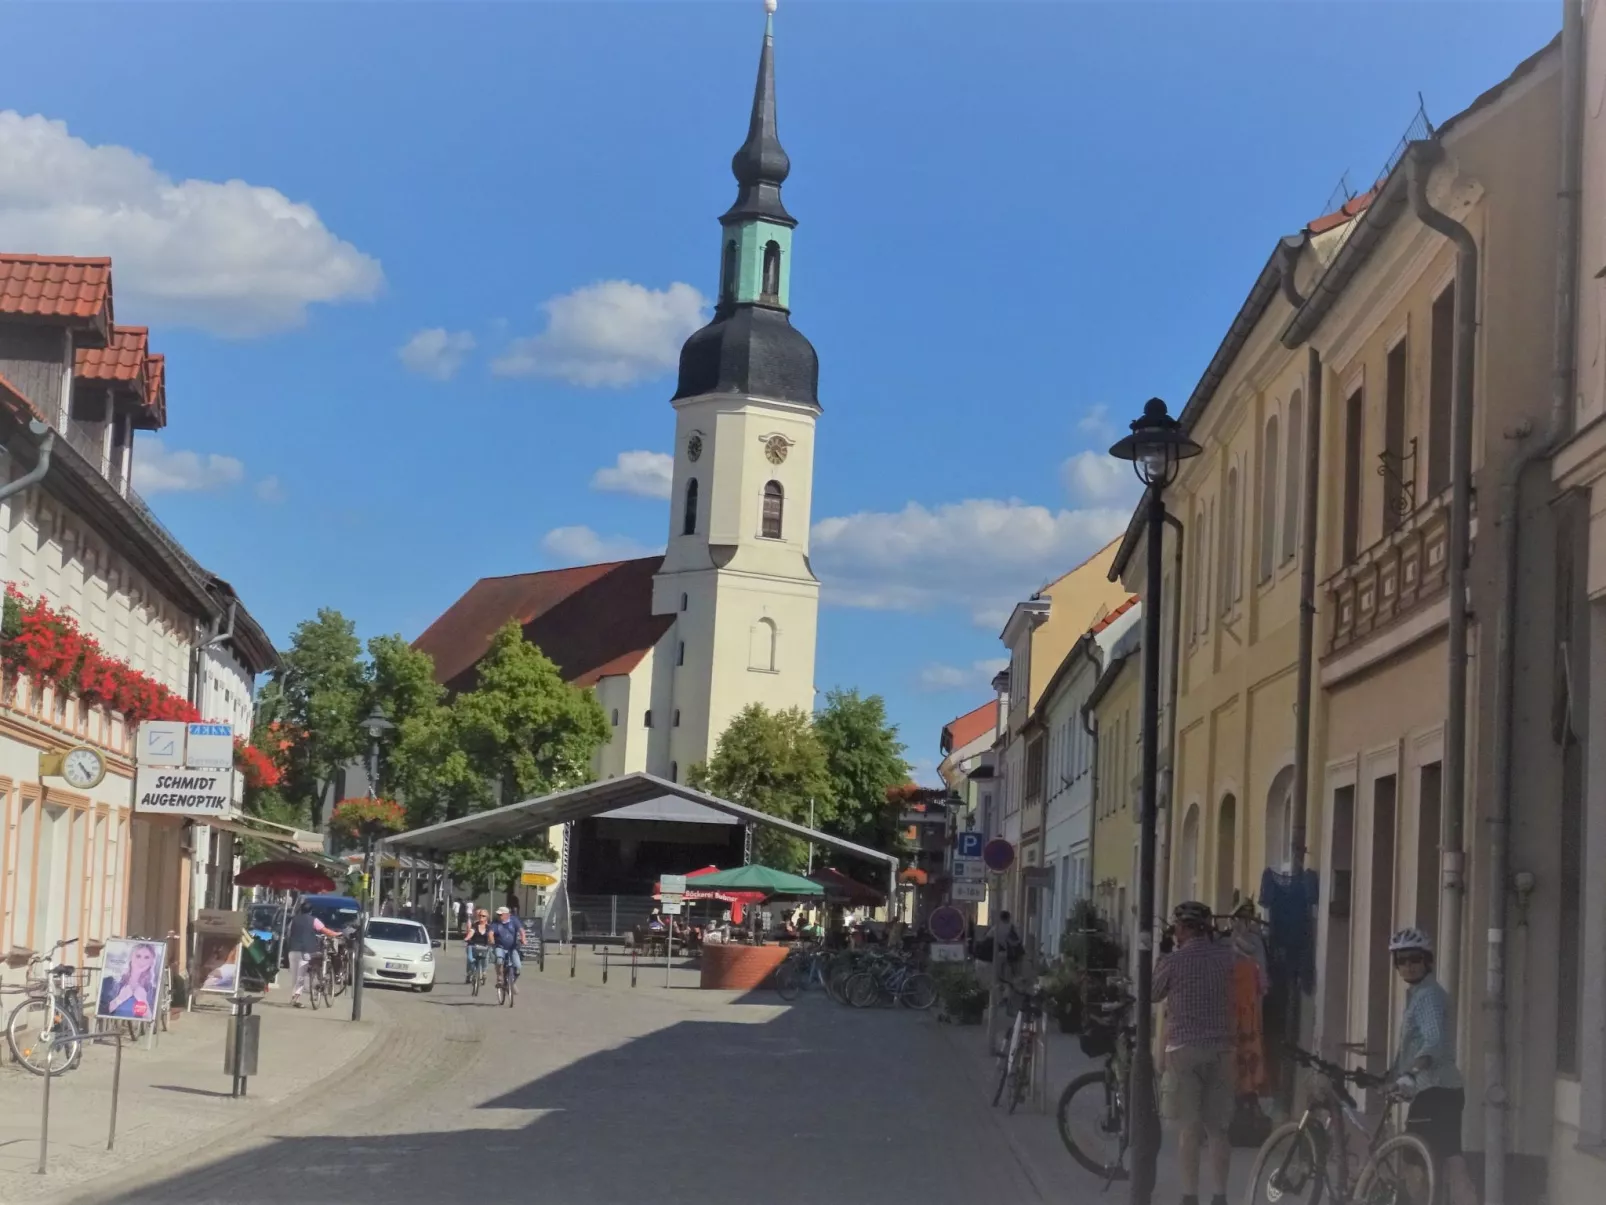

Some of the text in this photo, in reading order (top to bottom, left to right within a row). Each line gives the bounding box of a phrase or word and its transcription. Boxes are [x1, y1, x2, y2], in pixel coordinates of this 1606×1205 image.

[155, 775, 217, 791] SCHMIDT
[141, 792, 226, 810] AUGENOPTIK
[963, 835, 978, 854] P
